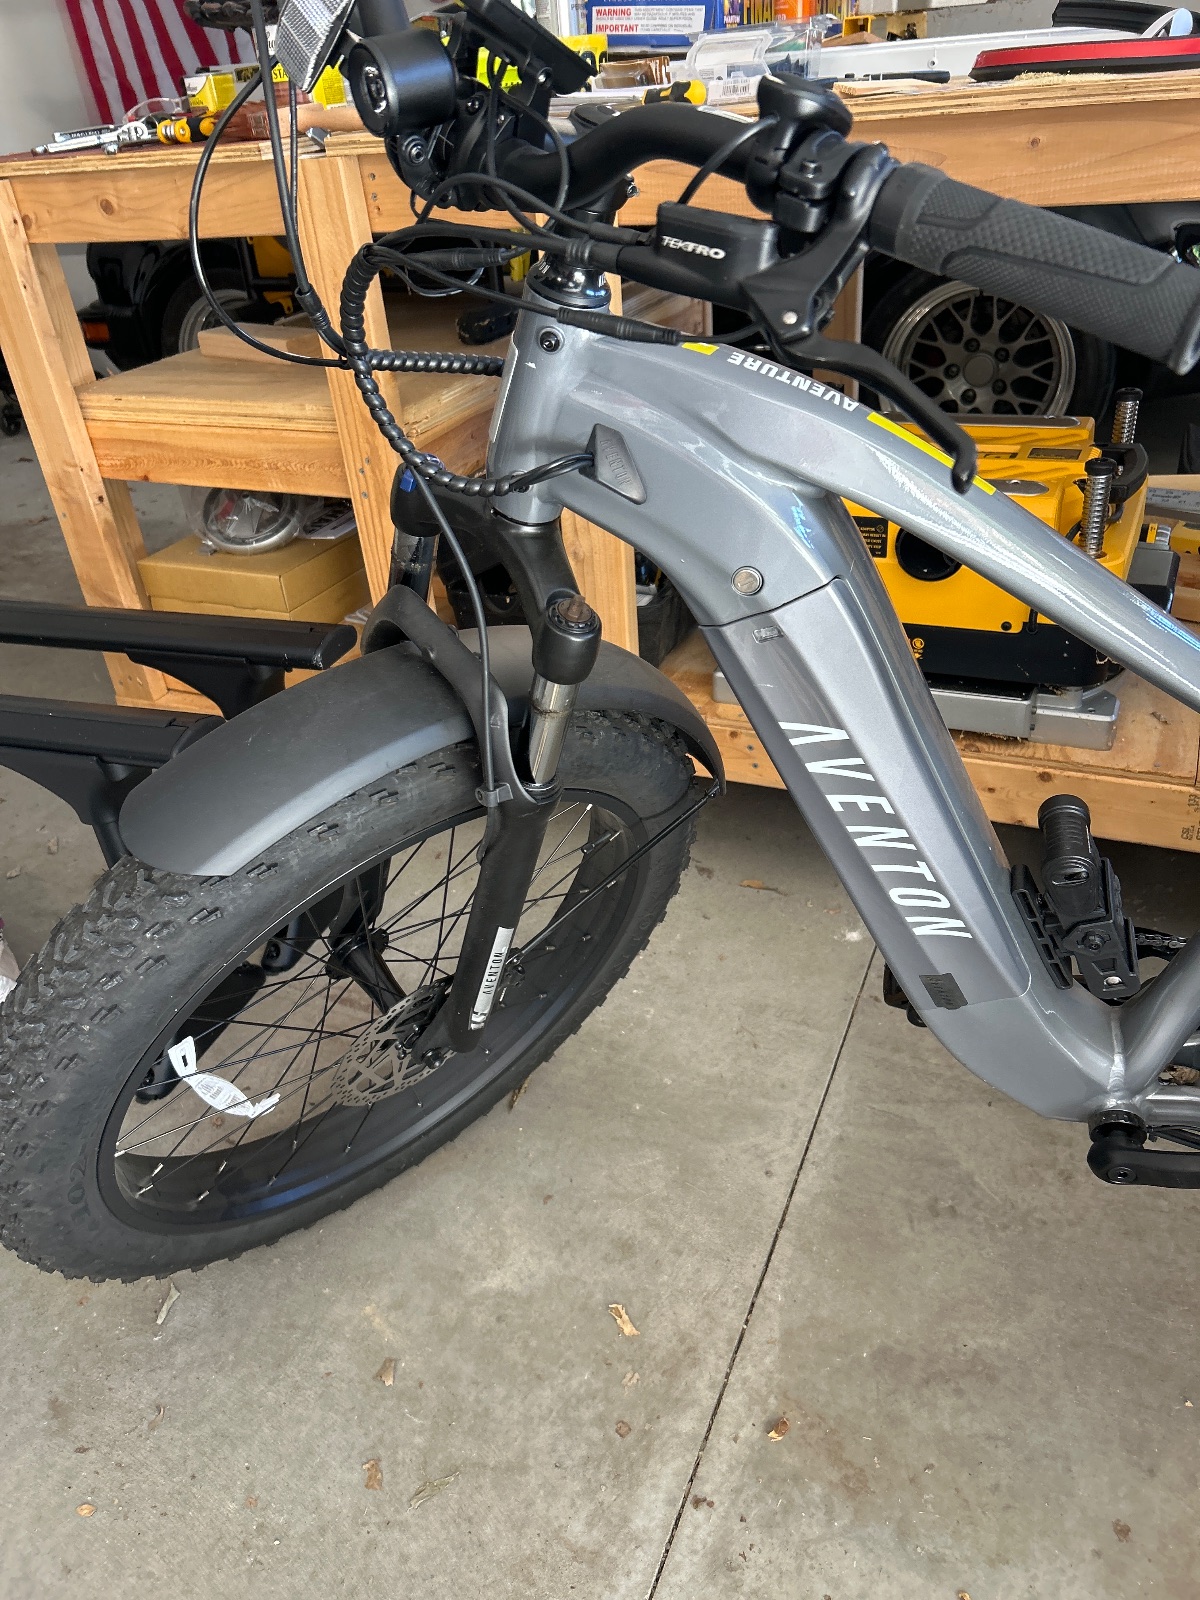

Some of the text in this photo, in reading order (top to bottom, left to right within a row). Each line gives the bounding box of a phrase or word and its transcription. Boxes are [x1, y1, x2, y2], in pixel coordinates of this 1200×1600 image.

[595, 8, 632, 17] WARNING
[595, 24, 639, 33] IMPORTANT
[661, 235, 727, 260] TEKTRO
[727, 351, 859, 412] AVENTURE
[778, 721, 973, 939] AVENTON
[482, 951, 504, 995] AVENTON
